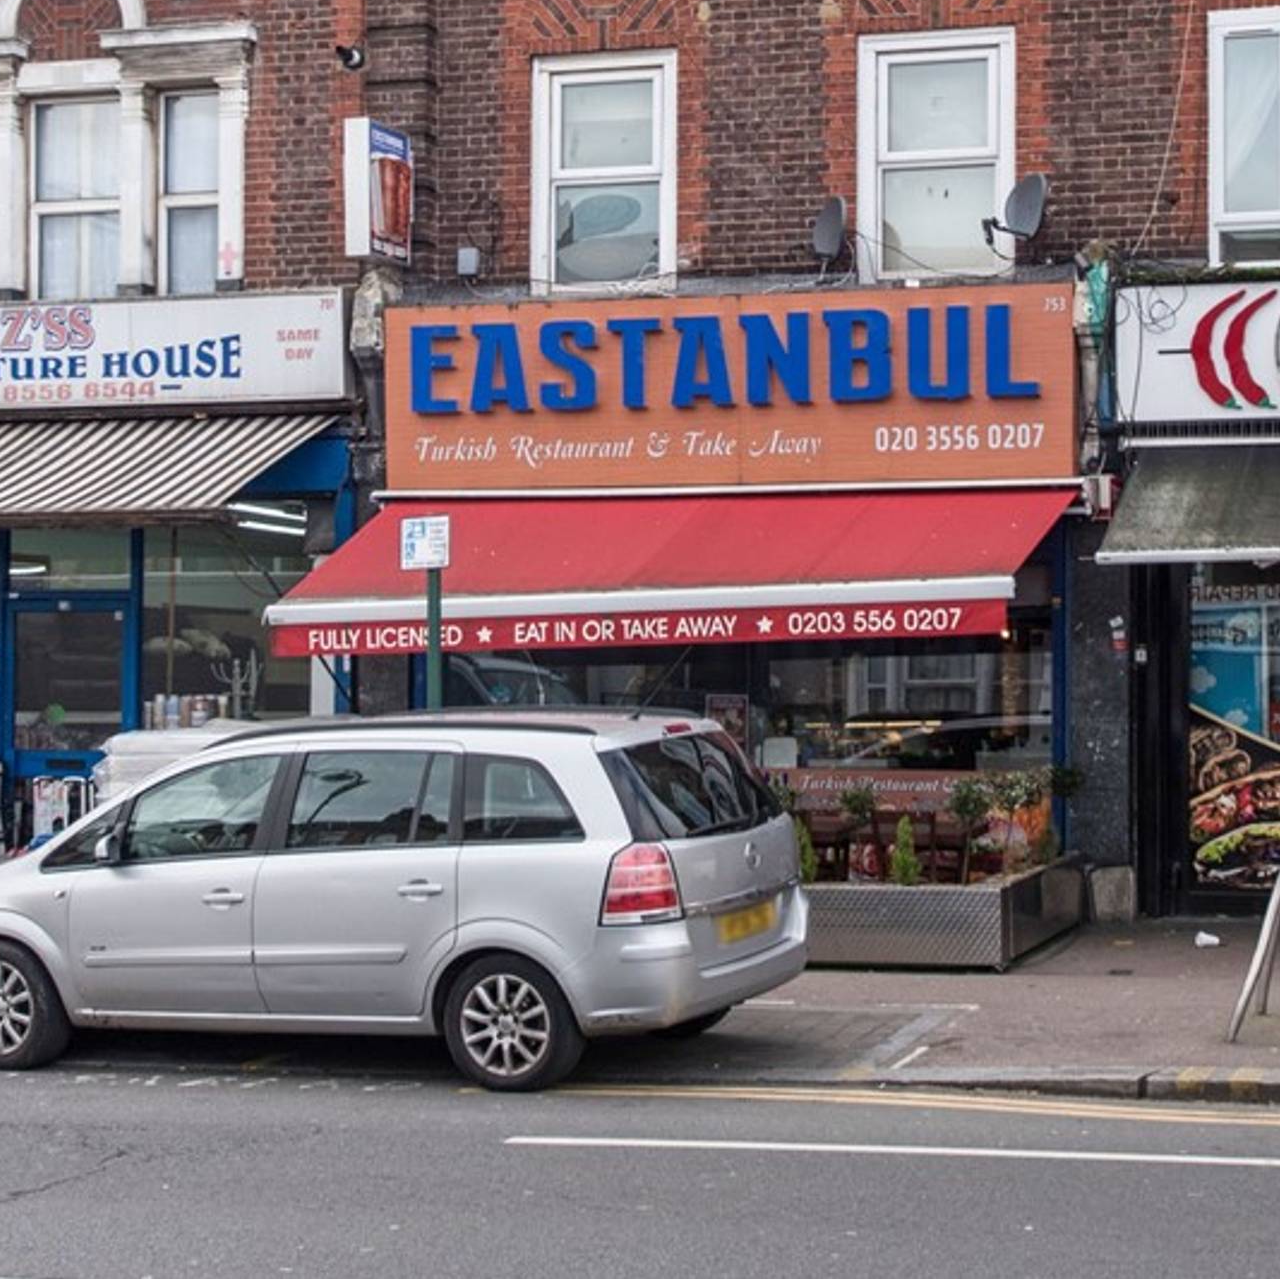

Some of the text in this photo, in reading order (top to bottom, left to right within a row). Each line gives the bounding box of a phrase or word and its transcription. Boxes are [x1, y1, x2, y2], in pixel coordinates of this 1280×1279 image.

[1045, 297, 1067, 312] 753
[276, 328, 321, 342] SAME
[102, 333, 242, 379] HOUSE
[285, 348, 313, 361] DAY
[410, 304, 1041, 414] EASTANBUL
[3, 383, 73, 402] 8556
[83, 380, 156, 400] 6544
[414, 429, 822, 468] Turkish Restaurant & Take Away
[874, 423, 1046, 452] 020 3556 0207
[308, 628, 361, 651] FULLY
[514, 621, 548, 643] EAT
[554, 620, 577, 642] IN
[582, 619, 616, 641] OR
[621, 617, 669, 640] TAKE
[674, 615, 738, 639] AWAY
[788, 612, 847, 635] 0203
[853, 610, 897, 633] 556
[903, 608, 962, 631] 0207
[800, 774, 854, 792] Turkish
